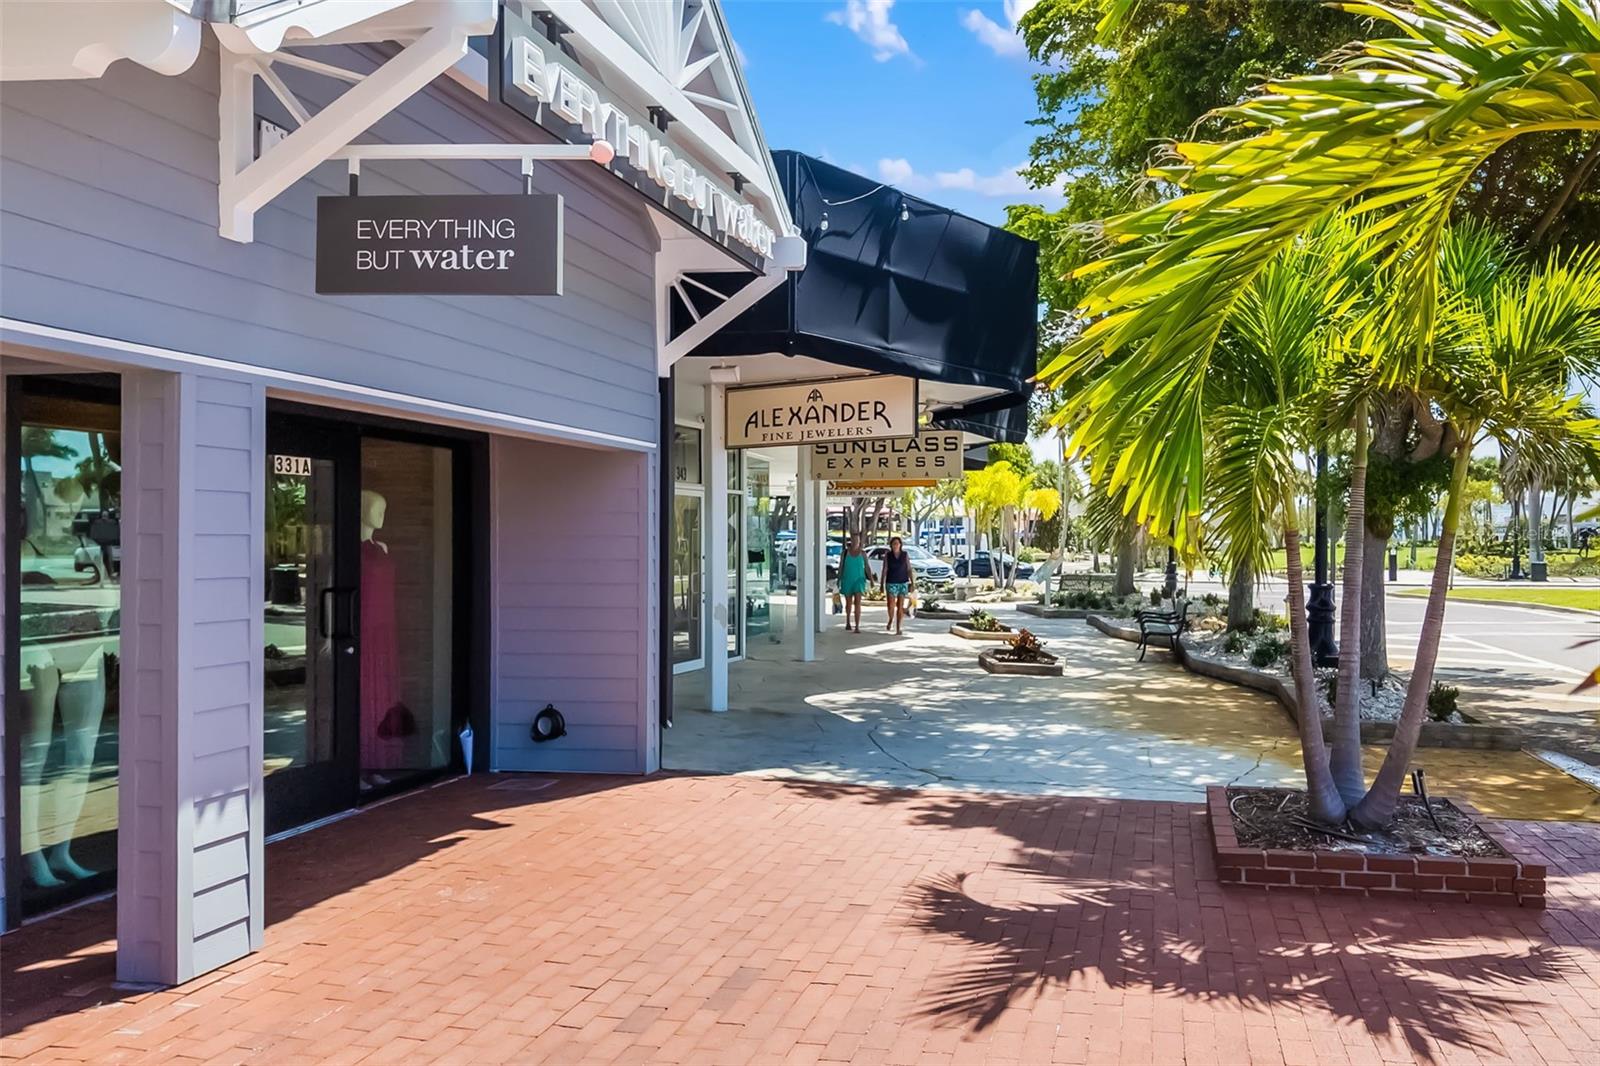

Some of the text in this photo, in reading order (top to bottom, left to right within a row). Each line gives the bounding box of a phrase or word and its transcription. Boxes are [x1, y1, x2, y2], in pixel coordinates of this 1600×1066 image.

[356, 218, 515, 239] EVERYTHING
[356, 244, 515, 270] BUT water
[744, 400, 892, 438] ALEXANDER
[762, 426, 873, 441] FINE JEWELERS
[815, 436, 959, 455] SUNGLASS
[275, 456, 310, 474] 331A
[826, 455, 946, 469] EXPRESS
[676, 465, 687, 481] 343
